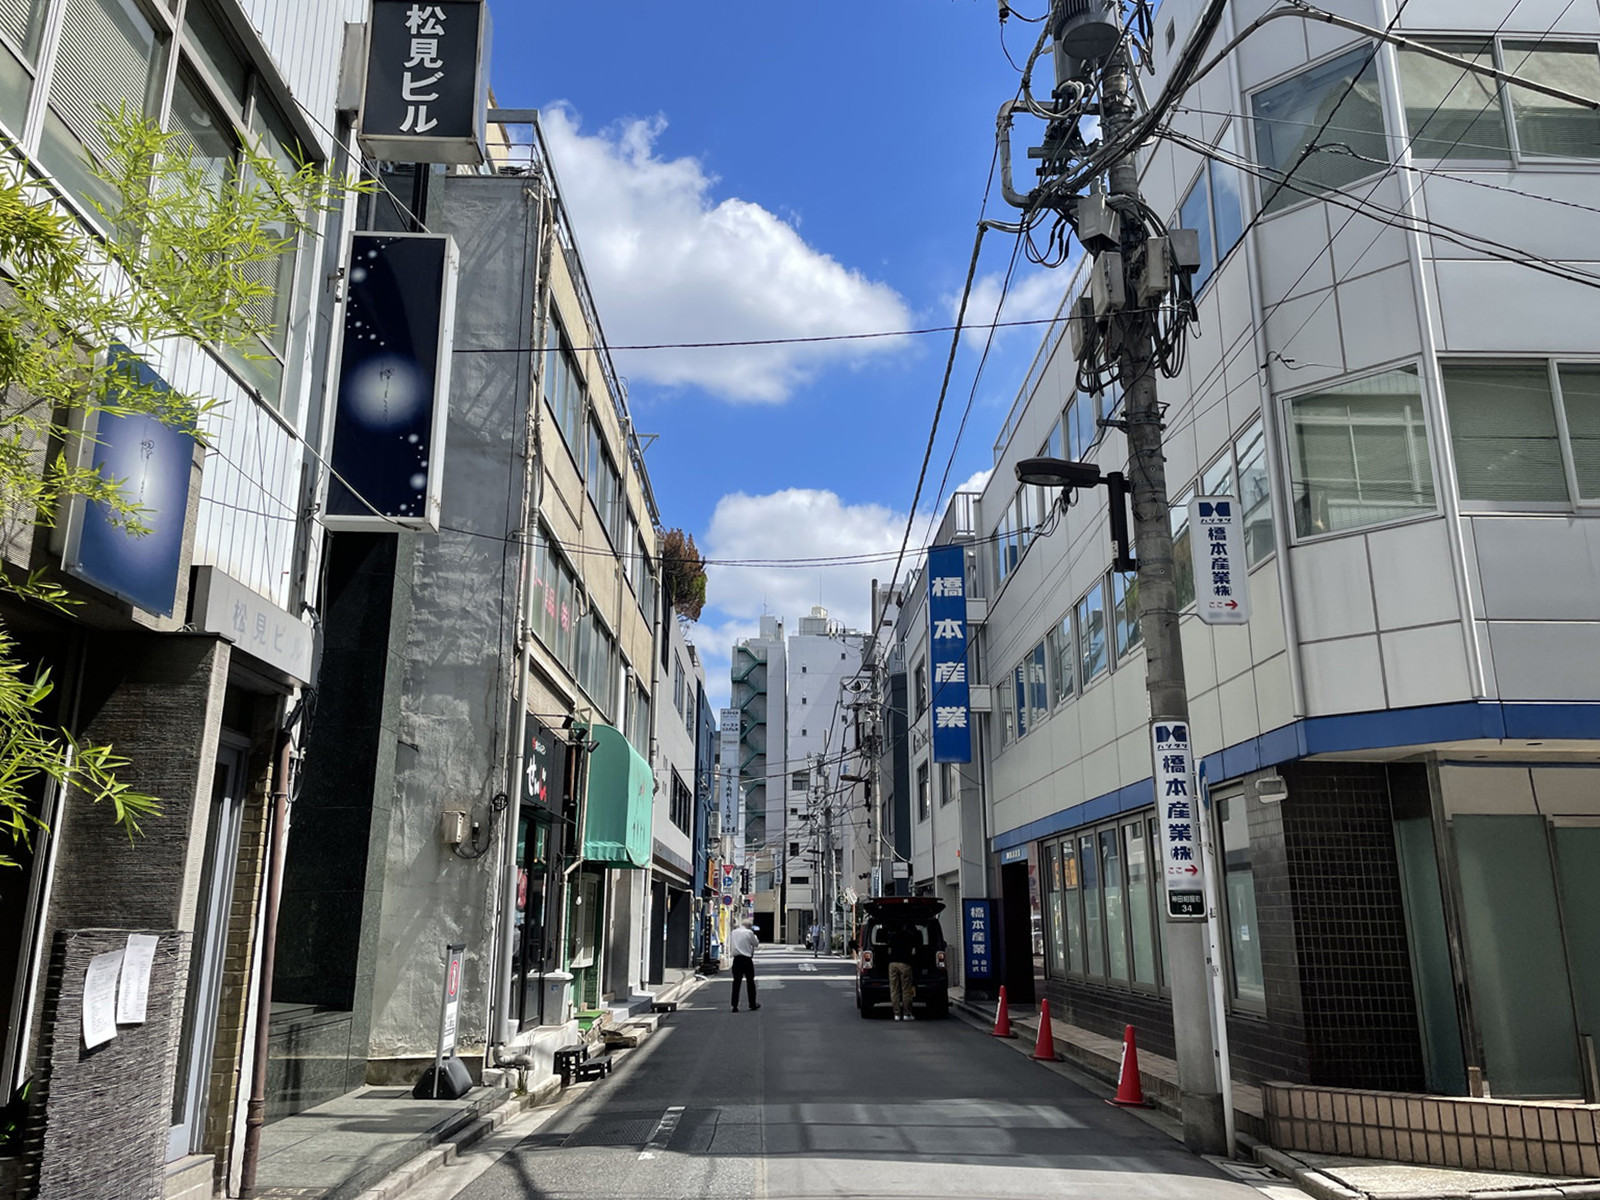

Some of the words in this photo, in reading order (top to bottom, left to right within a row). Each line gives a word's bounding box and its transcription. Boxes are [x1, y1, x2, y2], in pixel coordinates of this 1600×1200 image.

[399, 4, 447, 133] 松見ビル
[931, 576, 967, 728] 橋本産業
[1168, 866, 1182, 874] ここ
[970, 906, 986, 955] 橋本産業
[1181, 904, 1193, 913] 34
